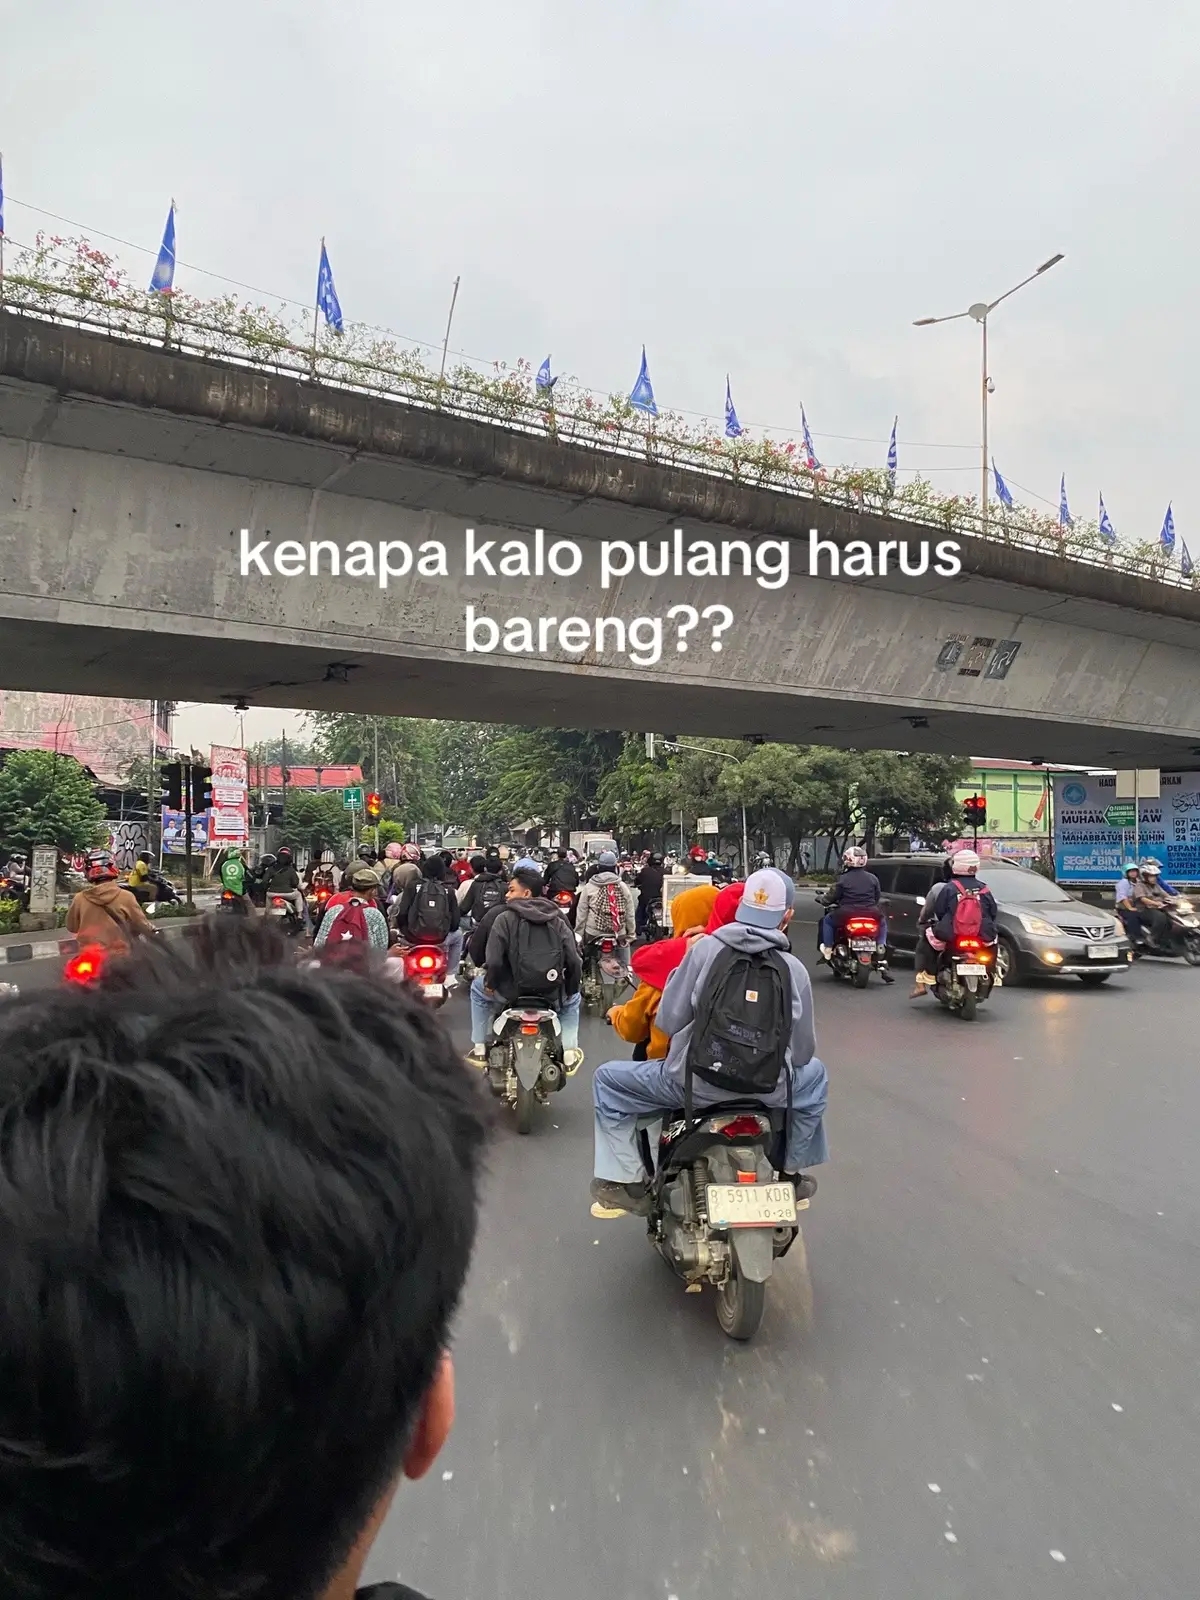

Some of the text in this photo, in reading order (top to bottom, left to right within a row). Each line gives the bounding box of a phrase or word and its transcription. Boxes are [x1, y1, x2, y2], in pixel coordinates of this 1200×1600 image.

[1175, 834, 1187, 842] 24
[1063, 855, 1096, 865] SEGAF
[1097, 856, 1118, 866] BIN
[727, 1188, 759, 1204] 5911
